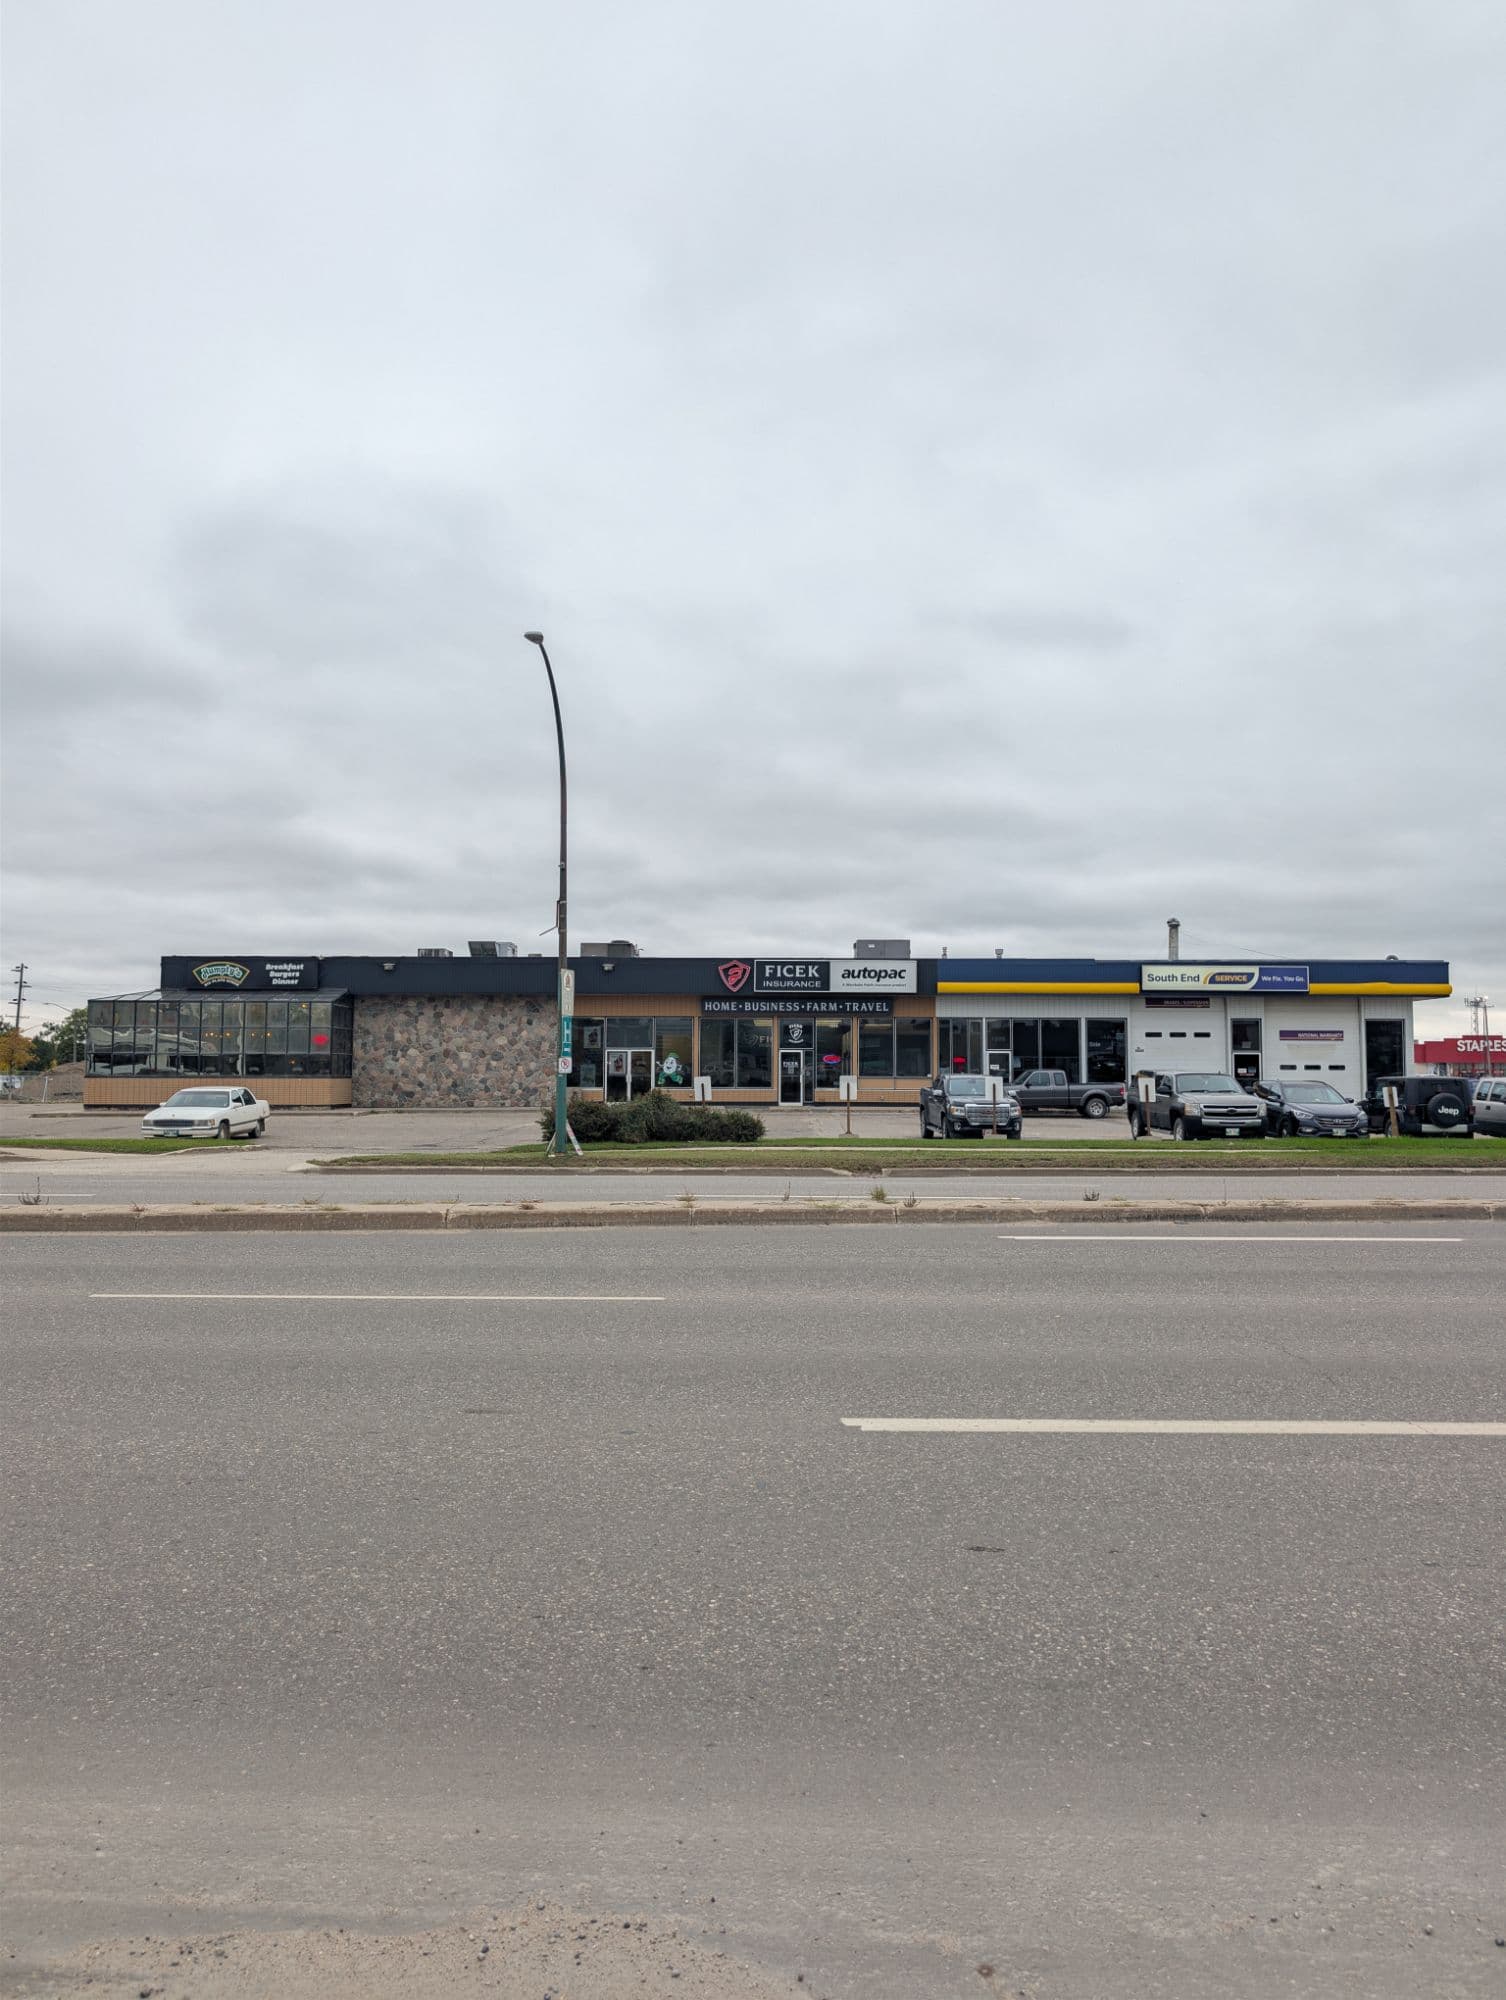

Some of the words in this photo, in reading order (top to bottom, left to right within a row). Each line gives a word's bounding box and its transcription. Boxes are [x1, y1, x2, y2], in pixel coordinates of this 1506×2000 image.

[201, 965, 243, 979] Humpty's
[265, 963, 304, 971] Breakfast
[765, 965, 820, 978] FICEK
[841, 966, 906, 982] autopac
[1147, 973, 1177, 982] South
[1181, 973, 1200, 982] End
[763, 980, 821, 988] INSURANCE
[704, 1001, 737, 1011] HOME
[744, 1001, 800, 1011] BUSINESS
[806, 1001, 838, 1012] FARM
[845, 1001, 889, 1012] TRAVEL
[1438, 1106, 1459, 1115] Jeep
